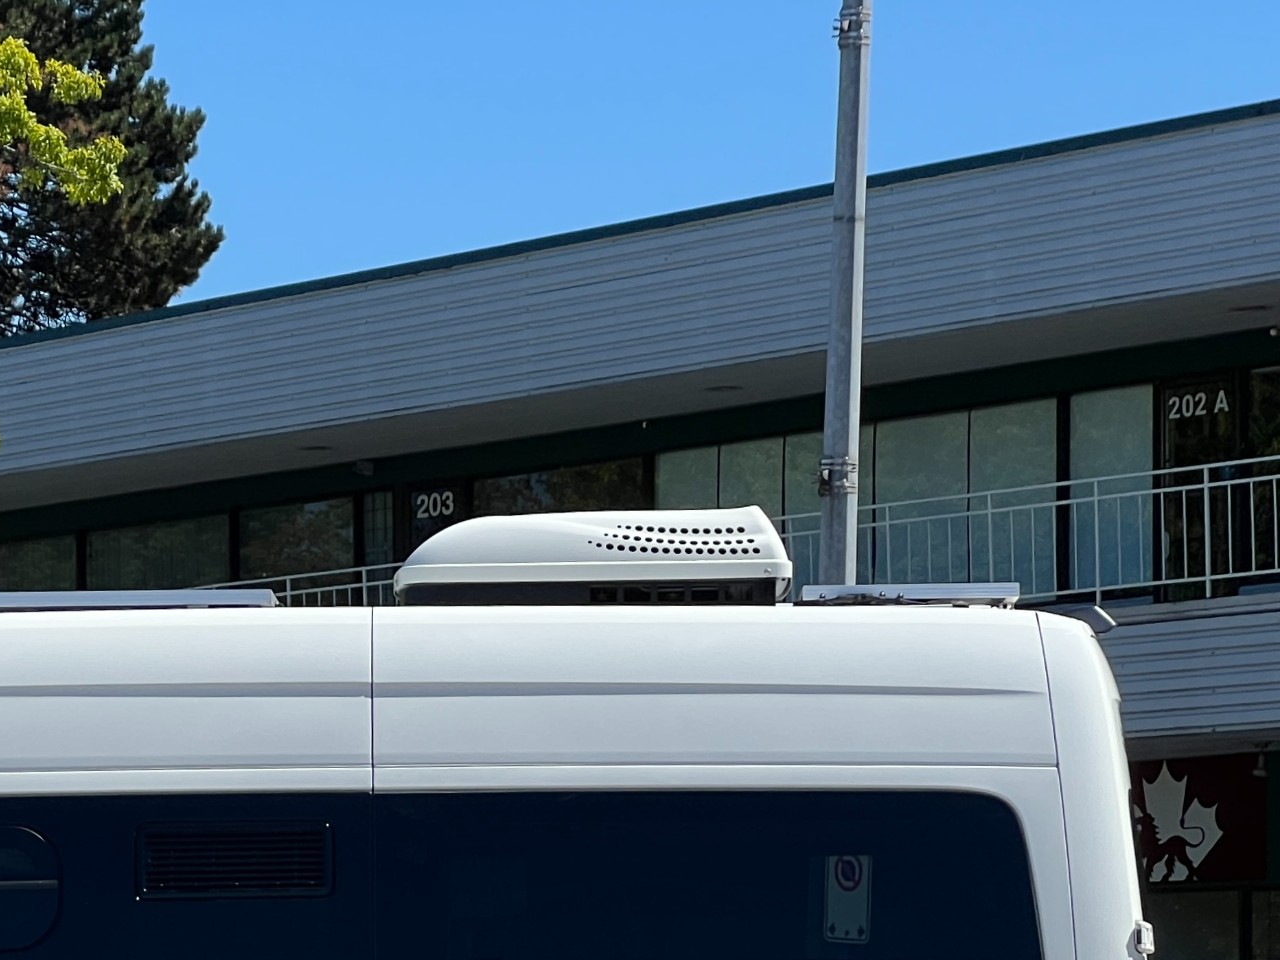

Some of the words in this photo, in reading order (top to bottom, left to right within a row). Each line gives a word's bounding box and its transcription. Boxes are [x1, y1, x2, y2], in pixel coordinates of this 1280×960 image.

[1168, 392, 1207, 419] 202
[1213, 389, 1229, 413] A
[416, 490, 454, 519] 203
